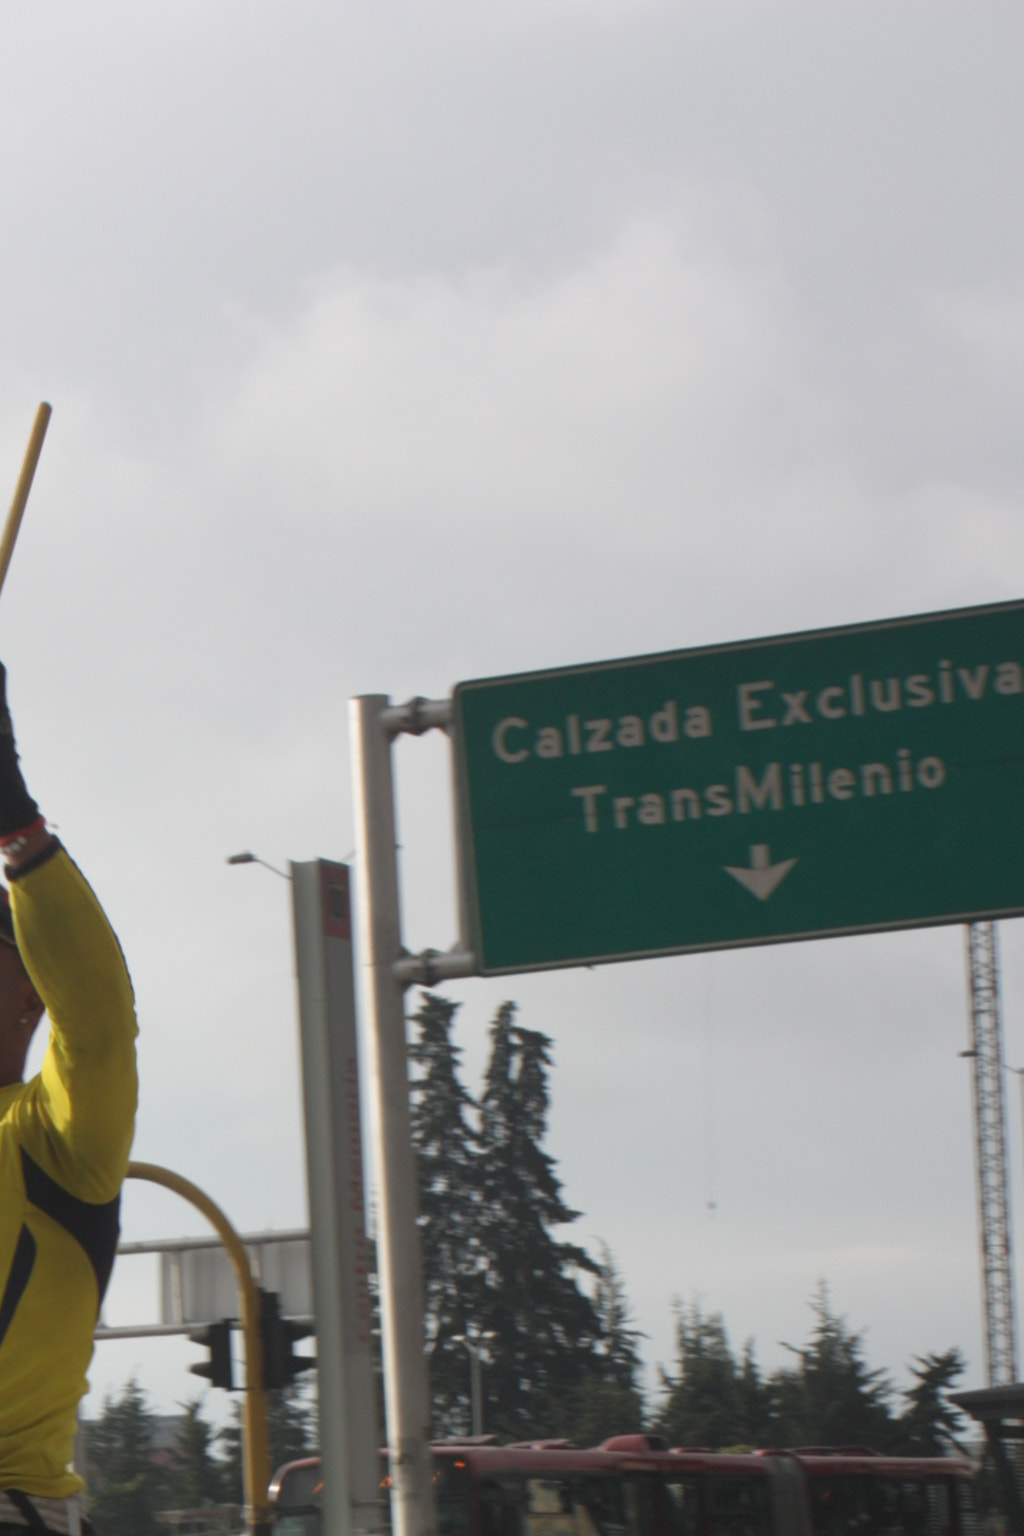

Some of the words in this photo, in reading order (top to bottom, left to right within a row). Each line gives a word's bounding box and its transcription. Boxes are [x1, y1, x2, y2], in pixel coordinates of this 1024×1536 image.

[492, 700, 712, 763] Calzada
[737, 658, 1024, 731] Exclusiva
[570, 748, 947, 833] TransMilenio
